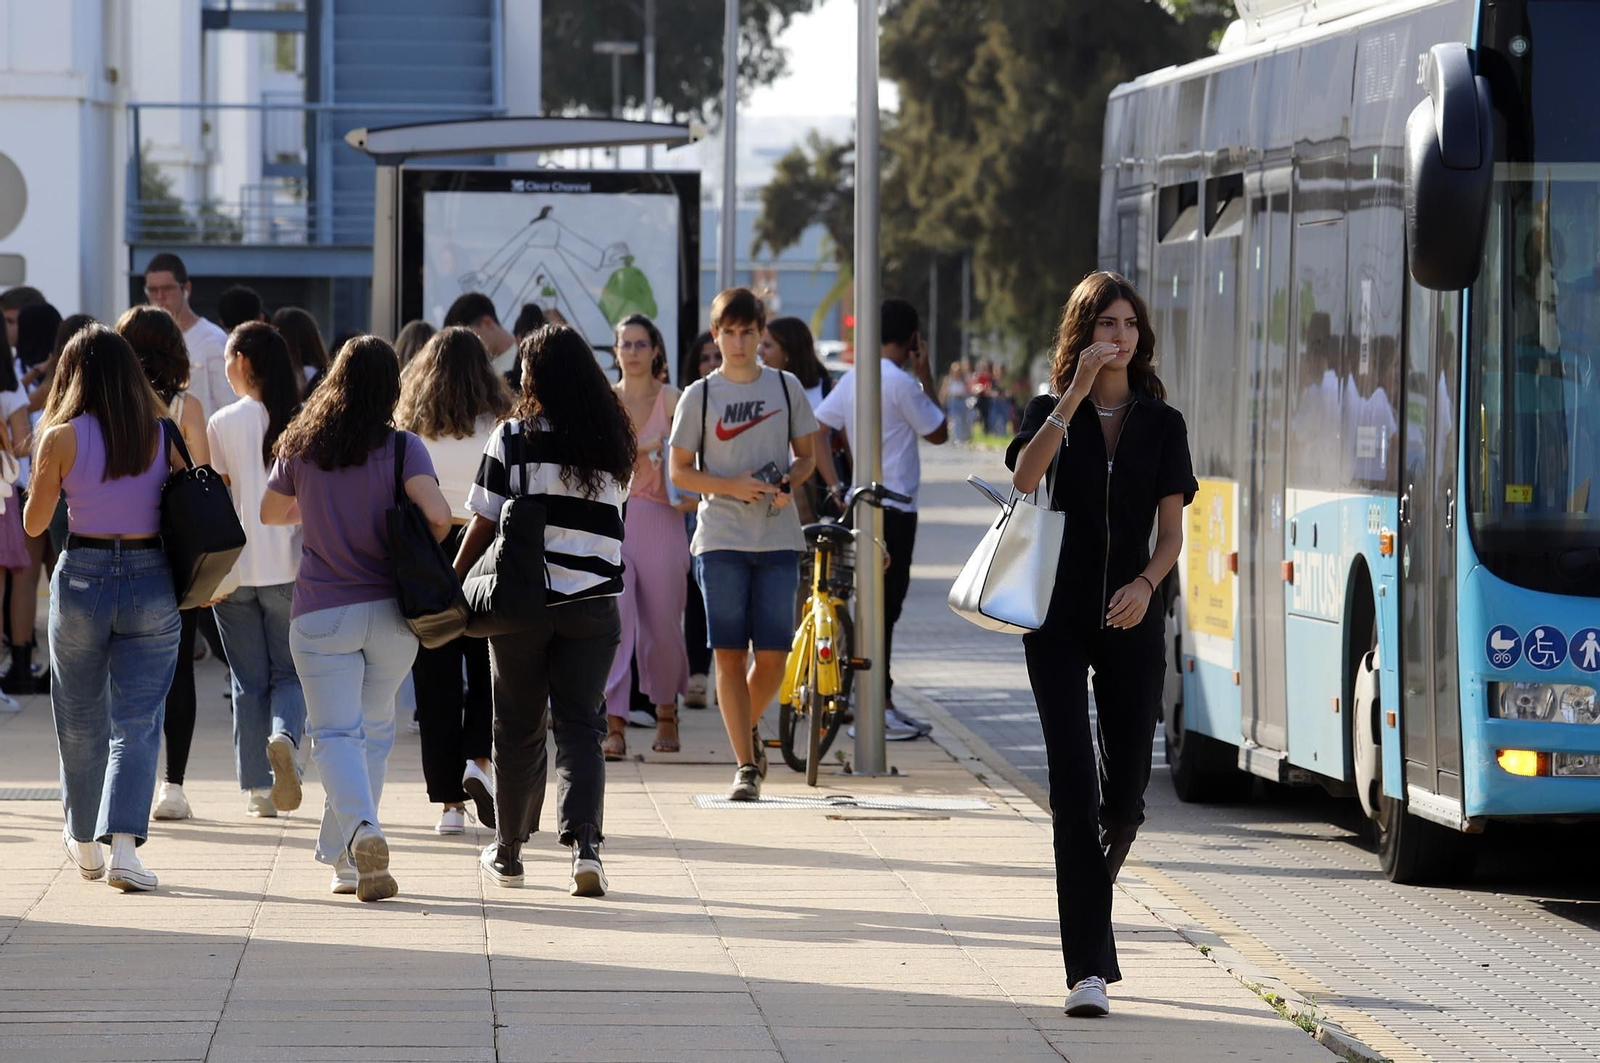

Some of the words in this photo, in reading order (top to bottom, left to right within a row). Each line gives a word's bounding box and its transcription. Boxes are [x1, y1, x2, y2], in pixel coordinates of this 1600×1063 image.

[525, 180, 550, 192] Clear
[551, 180, 592, 192] Channel
[723, 401, 766, 424] NIKE
[1293, 549, 1343, 618] EMTUSA
